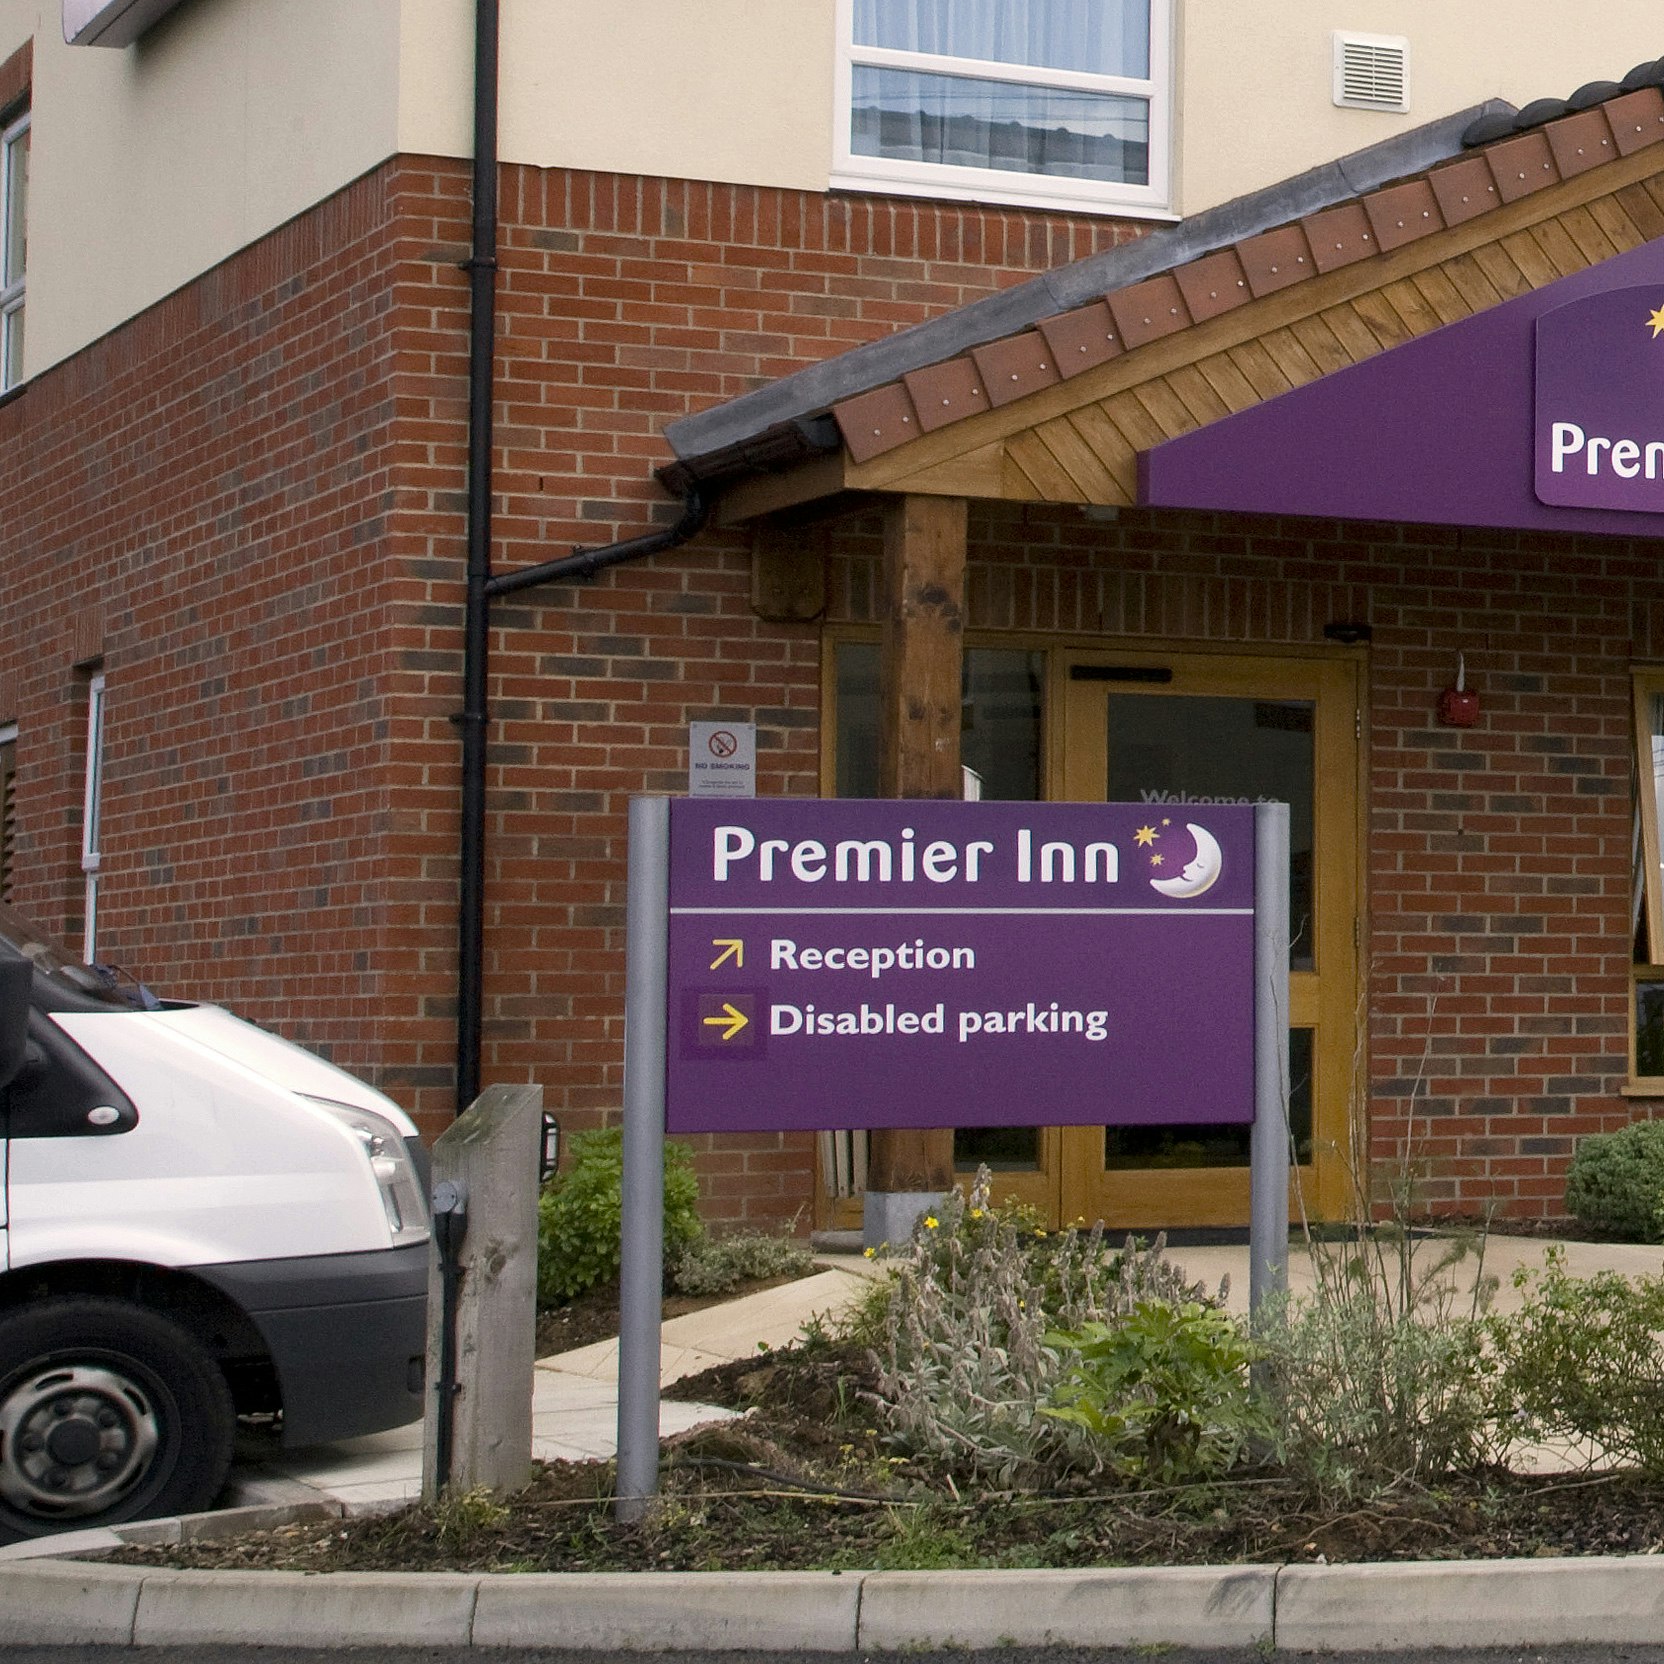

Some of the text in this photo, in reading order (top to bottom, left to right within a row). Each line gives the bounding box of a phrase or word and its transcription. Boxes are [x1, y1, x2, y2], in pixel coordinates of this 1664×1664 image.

[695, 762, 750, 771] NO SMOKING
[713, 824, 1120, 884] Premier Inn
[769, 938, 976, 978] Reception
[769, 1001, 1109, 1041] Disabled parking
